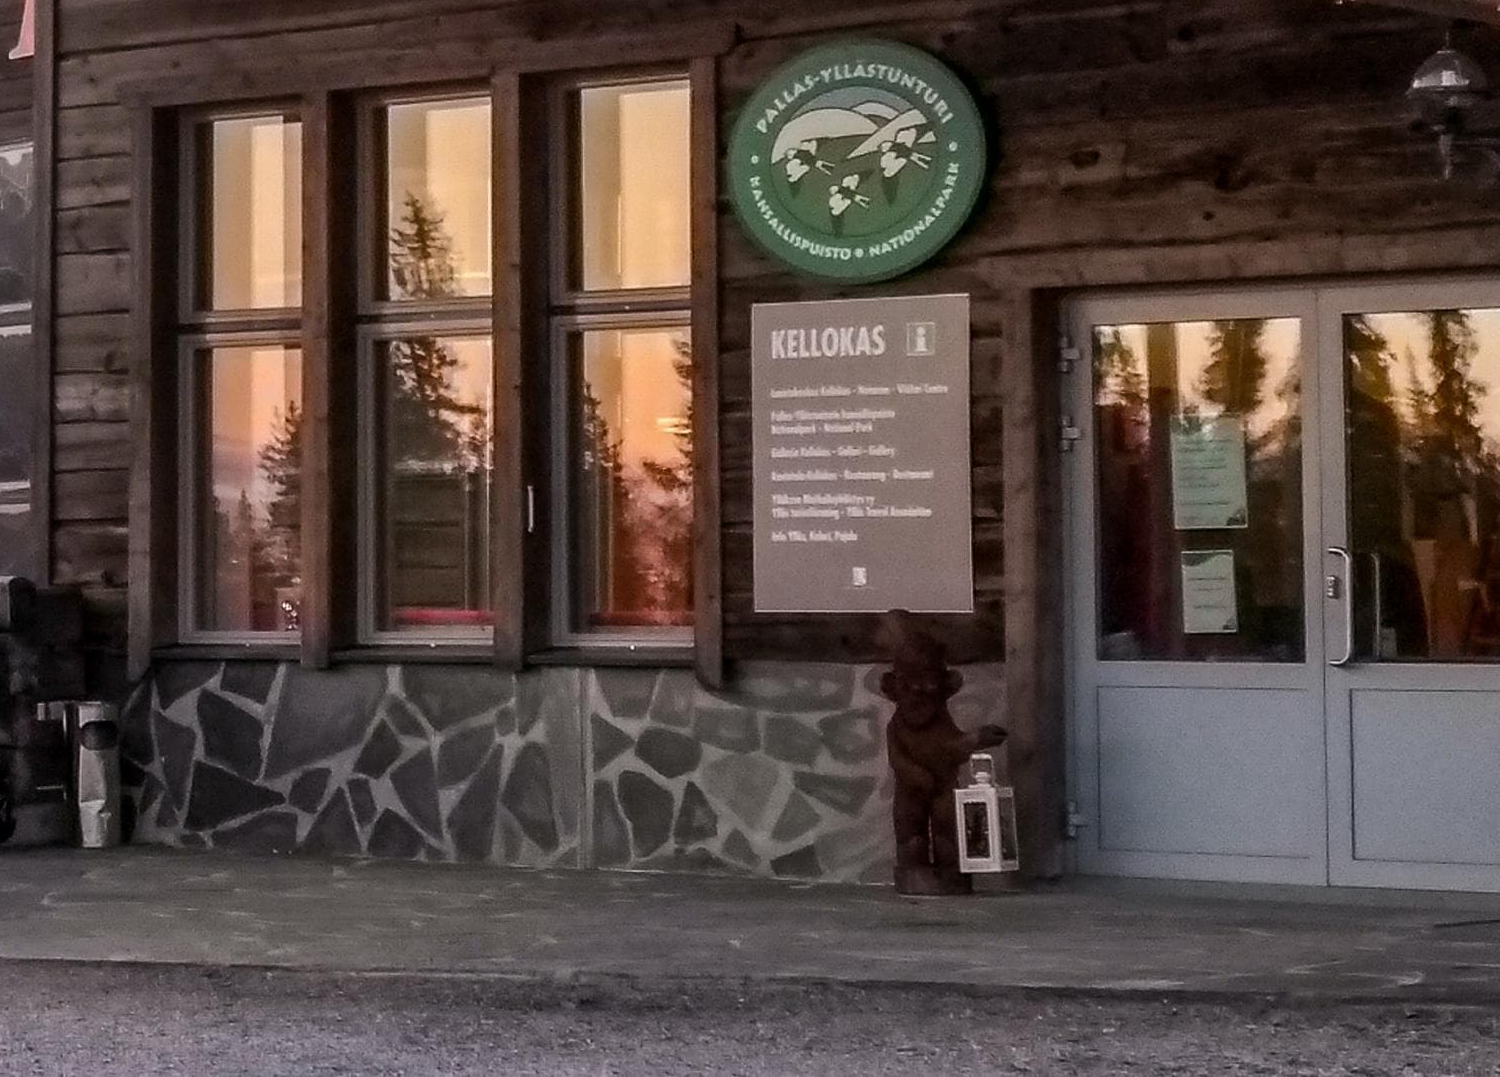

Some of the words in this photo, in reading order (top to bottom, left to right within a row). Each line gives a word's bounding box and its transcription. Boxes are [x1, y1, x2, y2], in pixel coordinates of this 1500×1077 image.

[750, 175, 851, 261] KANSALLISPUISTO
[869, 162, 960, 257] NATIONALPARK
[771, 325, 886, 359] KELLOKAS
